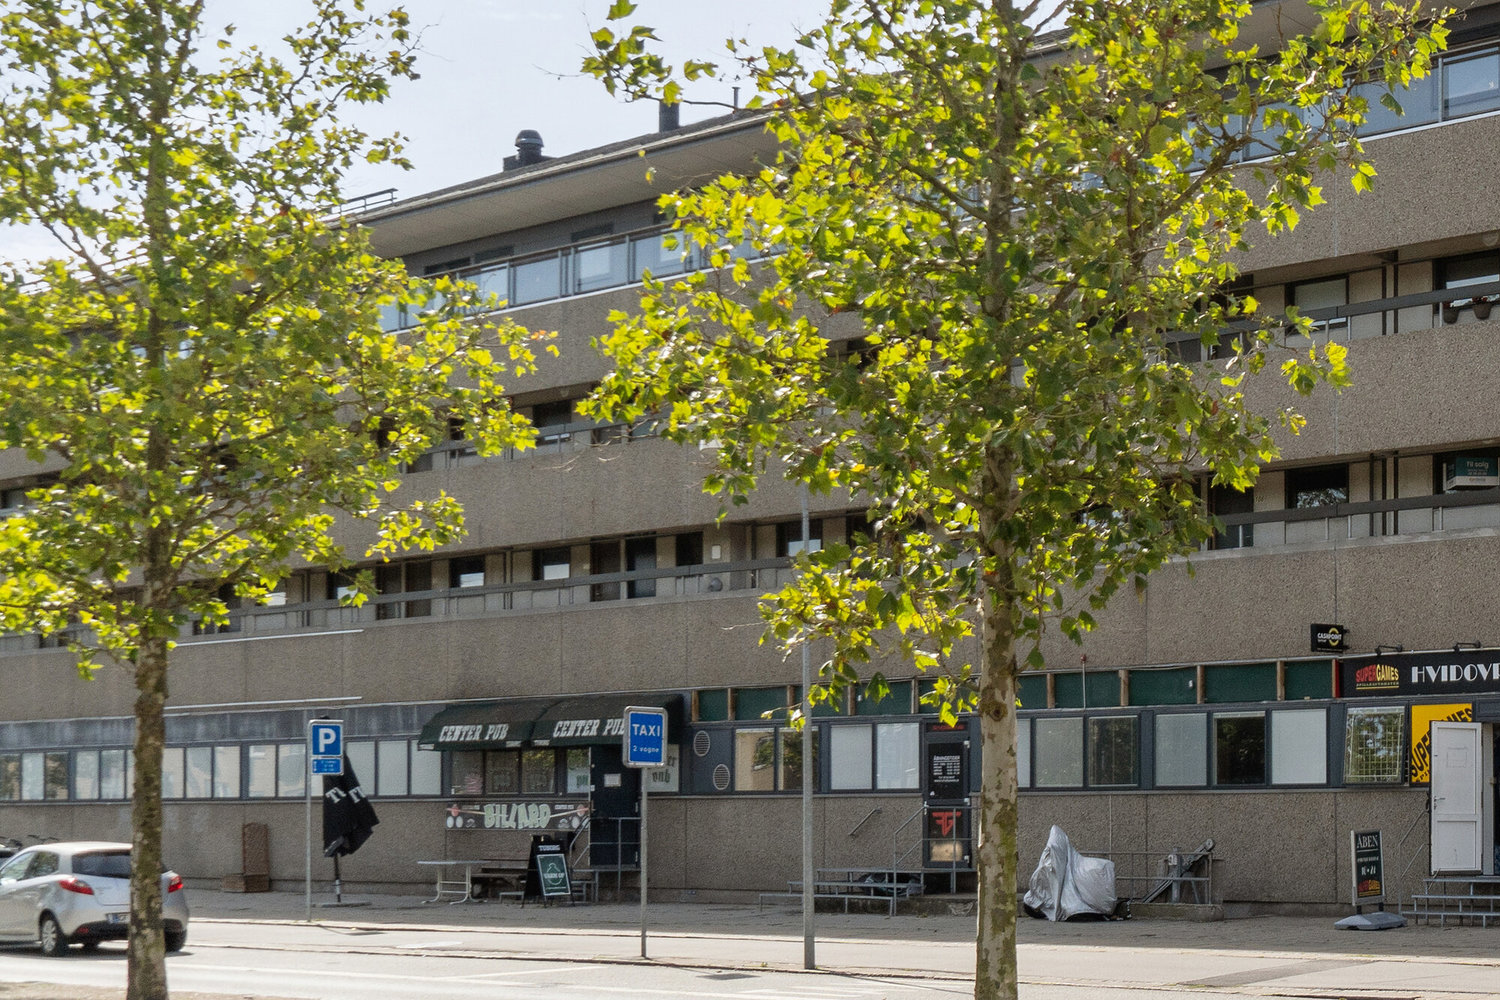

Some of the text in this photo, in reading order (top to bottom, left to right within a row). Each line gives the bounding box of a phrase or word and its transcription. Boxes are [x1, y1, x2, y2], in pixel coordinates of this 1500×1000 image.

[439, 724, 509, 742] CENTER PUB
[553, 719, 600, 738] CENTER
[632, 723, 661, 737] TAXI
[319, 728, 336, 753] P
[640, 746, 659, 754] vogne
[484, 803, 551, 829] BILLARD
